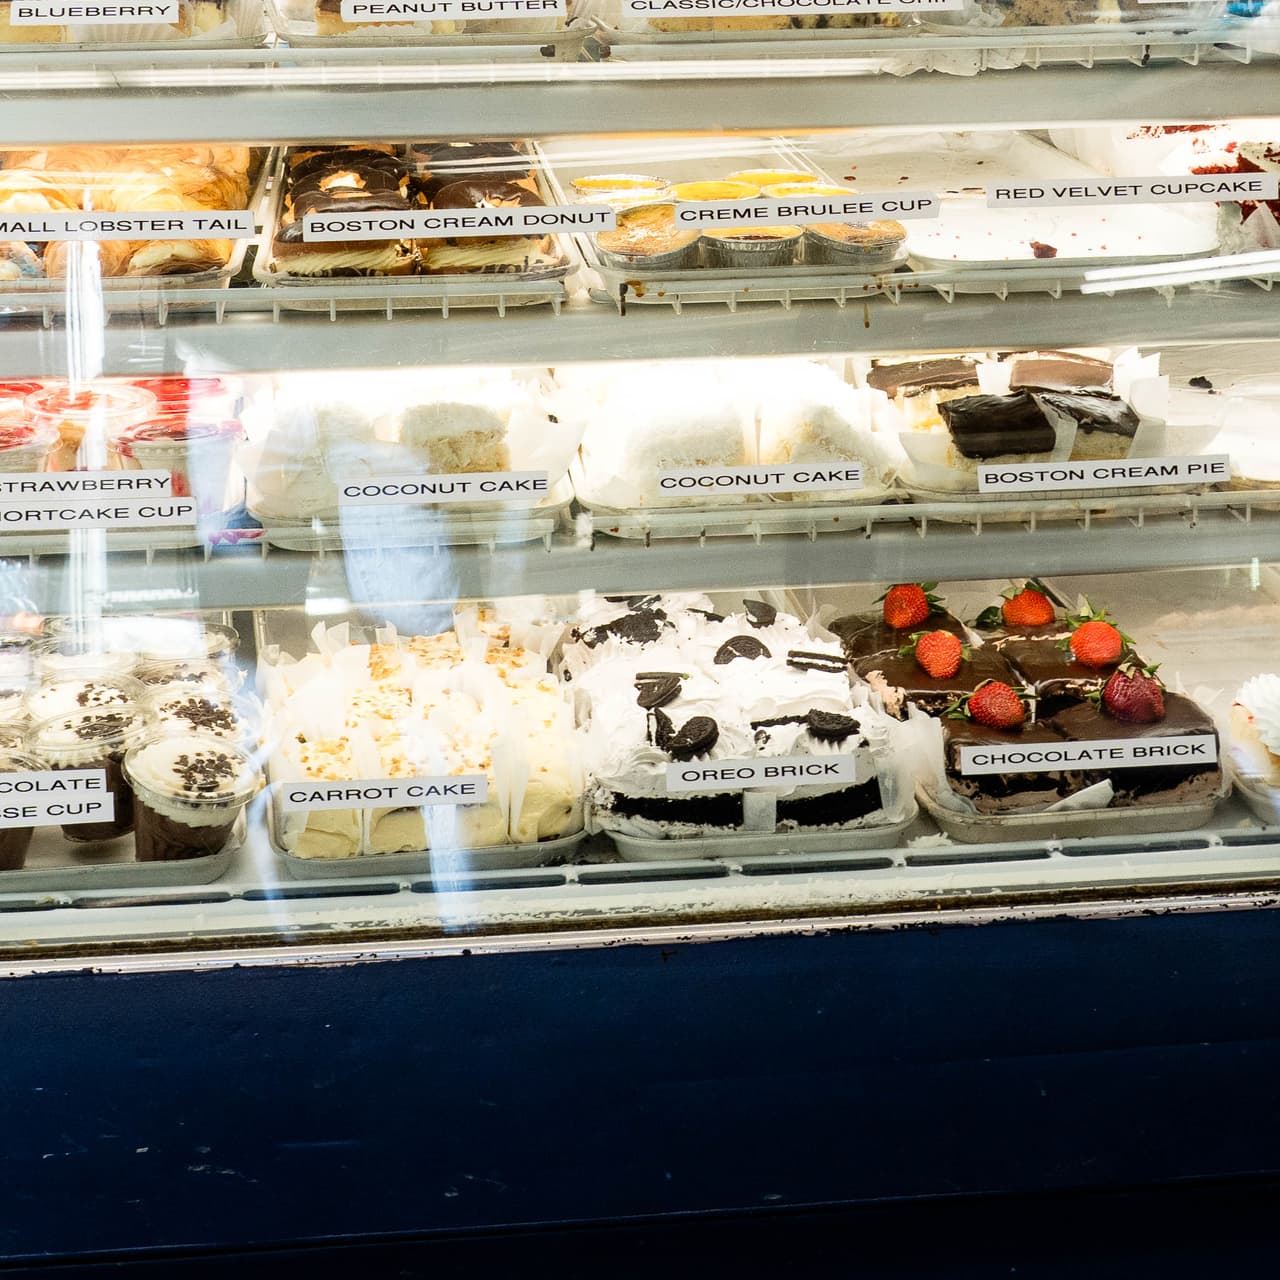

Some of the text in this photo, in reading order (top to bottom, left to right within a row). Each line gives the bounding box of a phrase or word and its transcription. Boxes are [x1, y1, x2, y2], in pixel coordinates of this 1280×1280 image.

[18, 5, 171, 18] BLUEBERRY
[353, 0, 558, 15] PEANUT BUTTER
[995, 180, 1263, 200] RED VELVET CUPCAKE
[680, 199, 932, 222] CREME BRULEE CUP
[65, 219, 184, 232] LOBSTER
[193, 219, 247, 230] TAIL
[310, 211, 611, 233] BOSTON CREAM DONUT
[660, 469, 860, 489] COCONUT CAKE
[984, 462, 1225, 484] BOSTON CREAM PIE
[343, 479, 548, 498] COCONUT CAKE
[138, 505, 193, 518] CUP
[971, 743, 1206, 766] CHOCOLATE BRICK
[681, 763, 840, 782] OREO BRICK
[289, 783, 476, 803] CARROT CAKE
[46, 802, 102, 816] CUP
